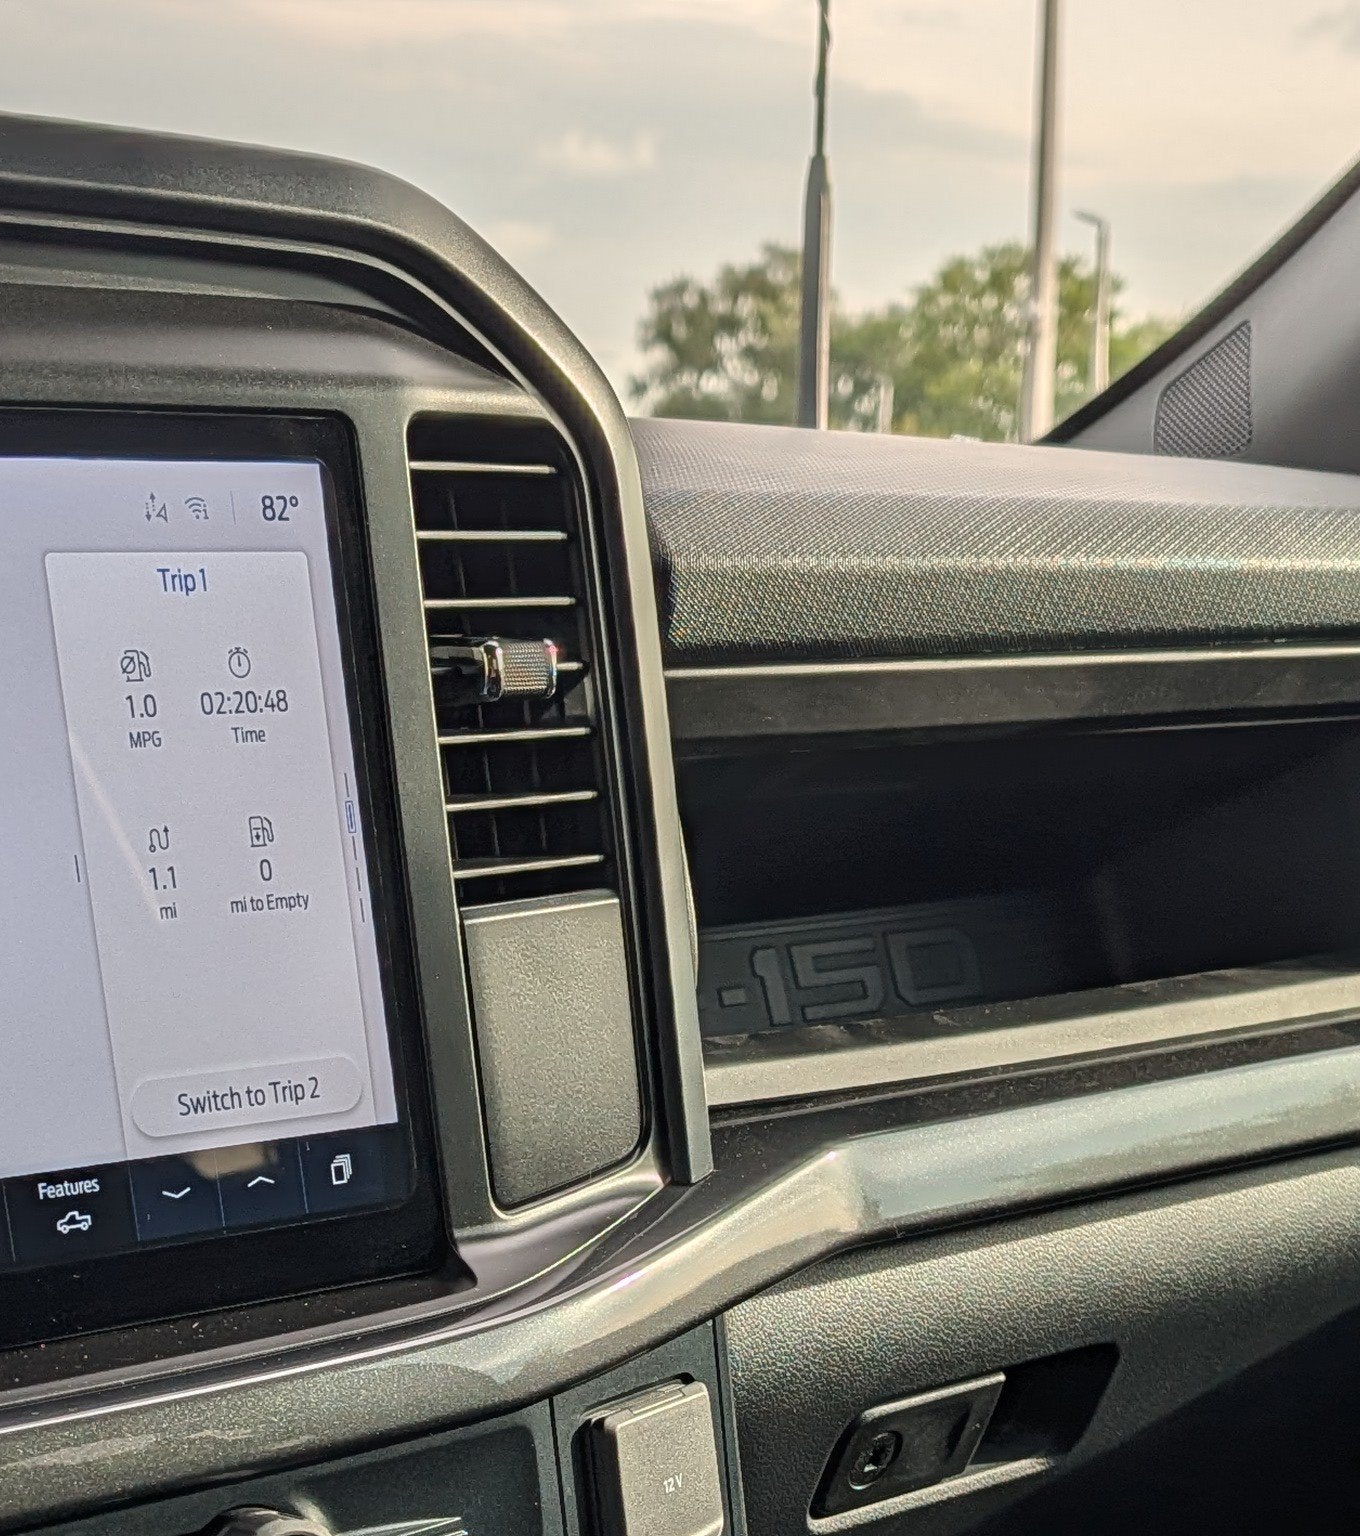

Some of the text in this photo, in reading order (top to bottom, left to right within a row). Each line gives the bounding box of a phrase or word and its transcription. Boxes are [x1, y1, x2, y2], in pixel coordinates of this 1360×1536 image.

[261, 494, 299, 522] 82°
[156, 568, 208, 596] Trip 1
[125, 693, 158, 719] 1.0
[200, 689, 290, 716] 02:20:48
[128, 730, 162, 749] MPG
[230, 726, 266, 745] Time
[148, 865, 177, 891] 1.1
[259, 858, 273, 882] 0
[159, 902, 178, 920] mi
[230, 892, 310, 914] mi to Empty
[717, 926, 982, 1027] -150
[177, 1076, 322, 1117] Switch to Trip 2
[37, 1175, 100, 1201] Features
